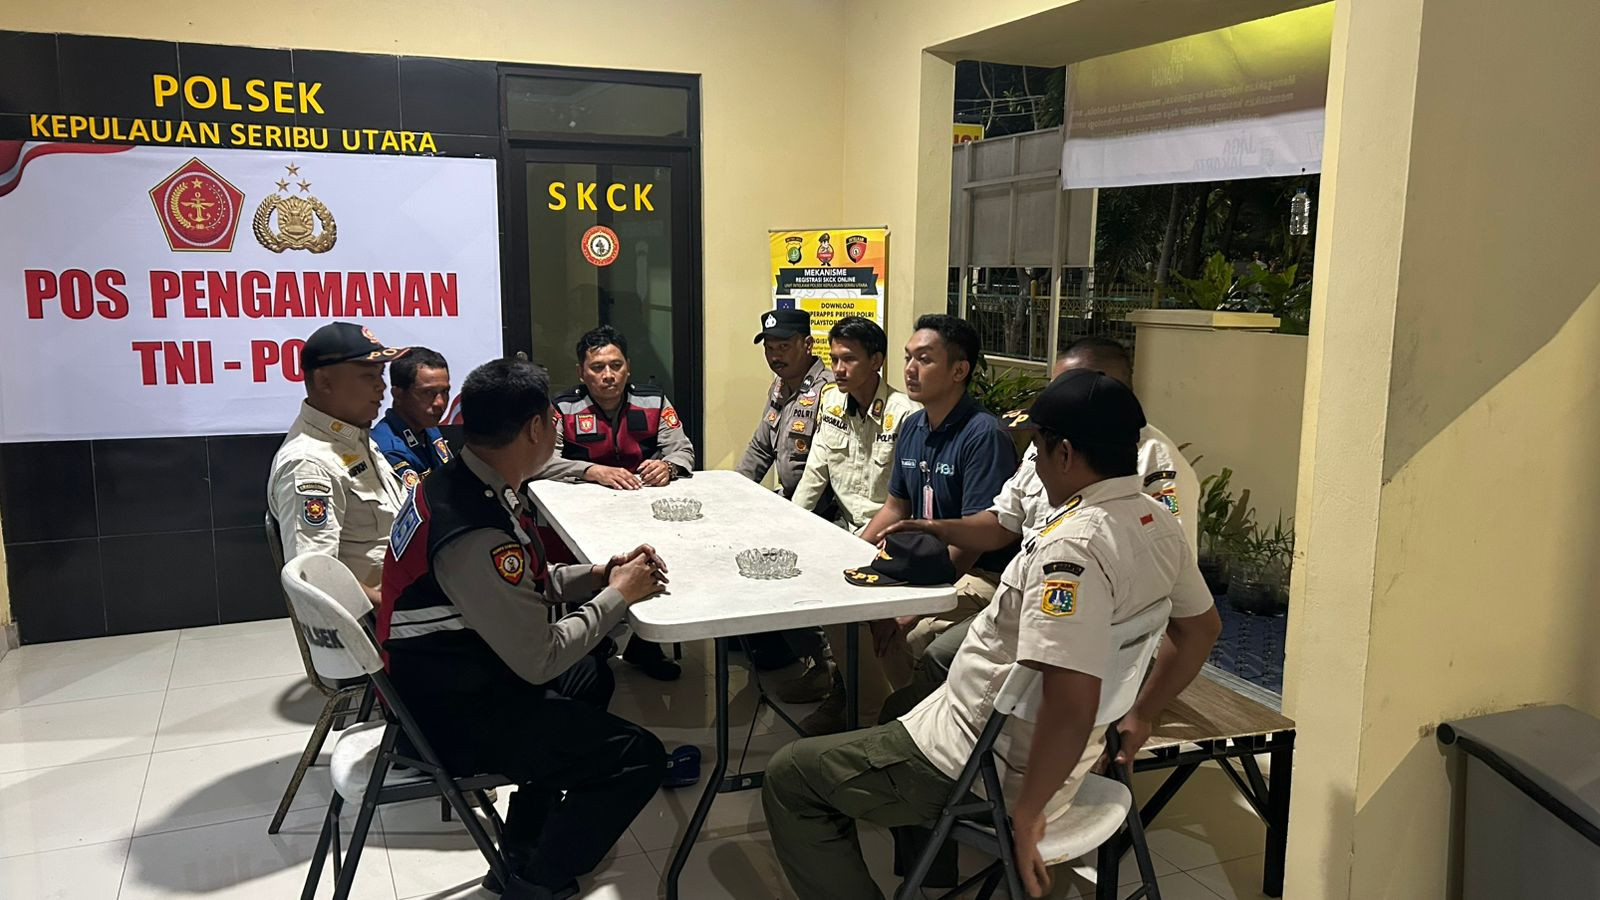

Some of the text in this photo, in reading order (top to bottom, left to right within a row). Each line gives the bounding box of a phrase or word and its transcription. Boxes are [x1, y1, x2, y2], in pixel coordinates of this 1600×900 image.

[153, 74, 325, 115] POLSEK
[30, 113, 438, 153] KEPULAUAN SERIBU UTARA
[548, 181, 655, 212] SKCK
[24, 269, 459, 320] POS PENGAMANAN
[132, 341, 214, 386] TNI
[251, 338, 306, 383] PO
[794, 409, 813, 418] POLRI
